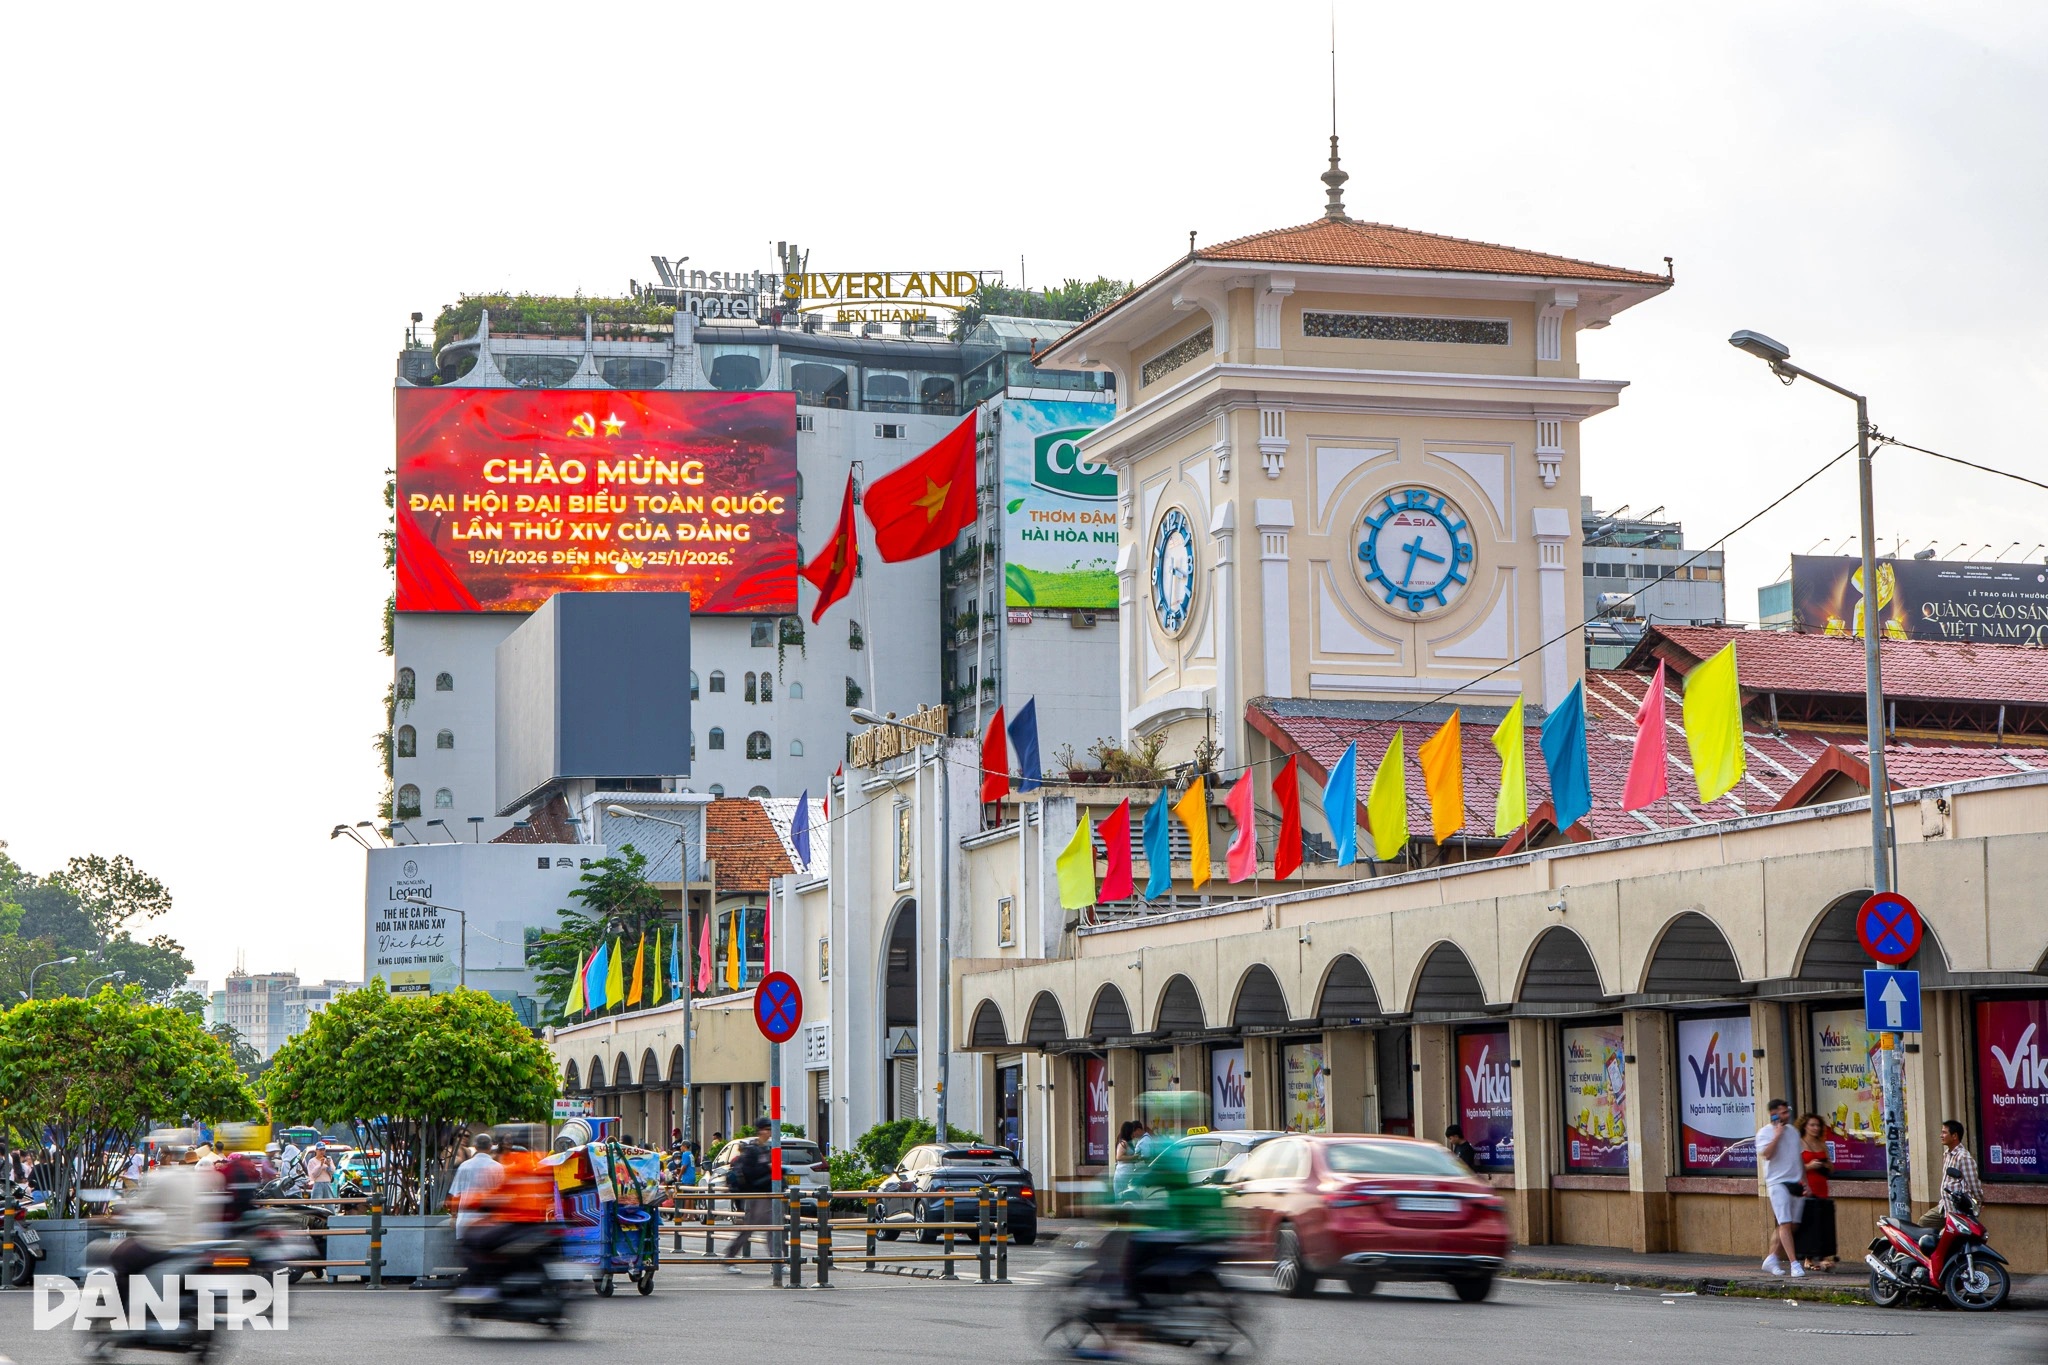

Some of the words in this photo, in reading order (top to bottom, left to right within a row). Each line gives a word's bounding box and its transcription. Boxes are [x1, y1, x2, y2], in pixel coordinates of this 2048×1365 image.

[784, 271, 977, 299] SILVERLAND
[686, 291, 757, 320] hotel
[837, 309, 869, 323] BEN
[871, 309, 927, 323] THANH
[483, 453, 587, 485] CHÀO
[597, 454, 705, 486] MỪNG
[409, 494, 455, 518] ĐẠI
[463, 489, 508, 518] HỘI
[515, 495, 561, 518] ĐẠI
[568, 488, 627, 514] BIỂU
[634, 491, 703, 514] TOÀN
[711, 490, 785, 517] QUỐC
[1404, 489, 1430, 509] 12
[452, 515, 503, 540] LẦN
[509, 517, 564, 540] THỨ
[569, 523, 612, 541] XIV
[618, 517, 672, 541] CỦA
[676, 517, 750, 541] ĐẢNG
[1029, 510, 1076, 523] THƠM
[1080, 510, 1116, 527] ĐẬM
[1022, 527, 1049, 541] HÀI
[1054, 528, 1089, 542] HÒA
[468, 548, 548, 565] 19/1/2026
[552, 547, 590, 565] ĐẾN
[595, 548, 643, 565] NGÀY
[1358, 541, 1376, 561] 9
[1457, 543, 1473, 563] 3
[1407, 591, 1424, 612] 6
[1922, 600, 1980, 622] QUẢNG
[1982, 602, 2016, 619] CÁO
[1939, 620, 1979, 638] VIỆT
[1982, 623, 2020, 638] NAM
[389, 884, 432, 901] Legend
[393, 921, 407, 931] TAN
[409, 919, 430, 931] RANG
[431, 918, 446, 929] XAY
[1819, 1025, 1841, 1047] Vikki
[1688, 1031, 1747, 1098] Vikki
[1821, 1062, 1834, 1074] TIẾT
[1850, 1063, 1865, 1073] Vikki
[1465, 1045, 1511, 1104] Vikki
[1821, 1078, 1837, 1088] Trúng
[1690, 1103, 1706, 1116] Ngân
[1706, 1103, 1721, 1116] hàng
[1722, 1101, 1735, 1113] Tiết
[1735, 1102, 1750, 1116] kiệm
[1993, 1093, 2015, 1107] Ngân
[2017, 1093, 2038, 1107] hàng
[1466, 1108, 1478, 1119] Ngân
[1479, 1108, 1490, 1119] hàng
[2003, 1156, 2018, 1164] 1900
[2020, 1156, 2036, 1164] 6608
